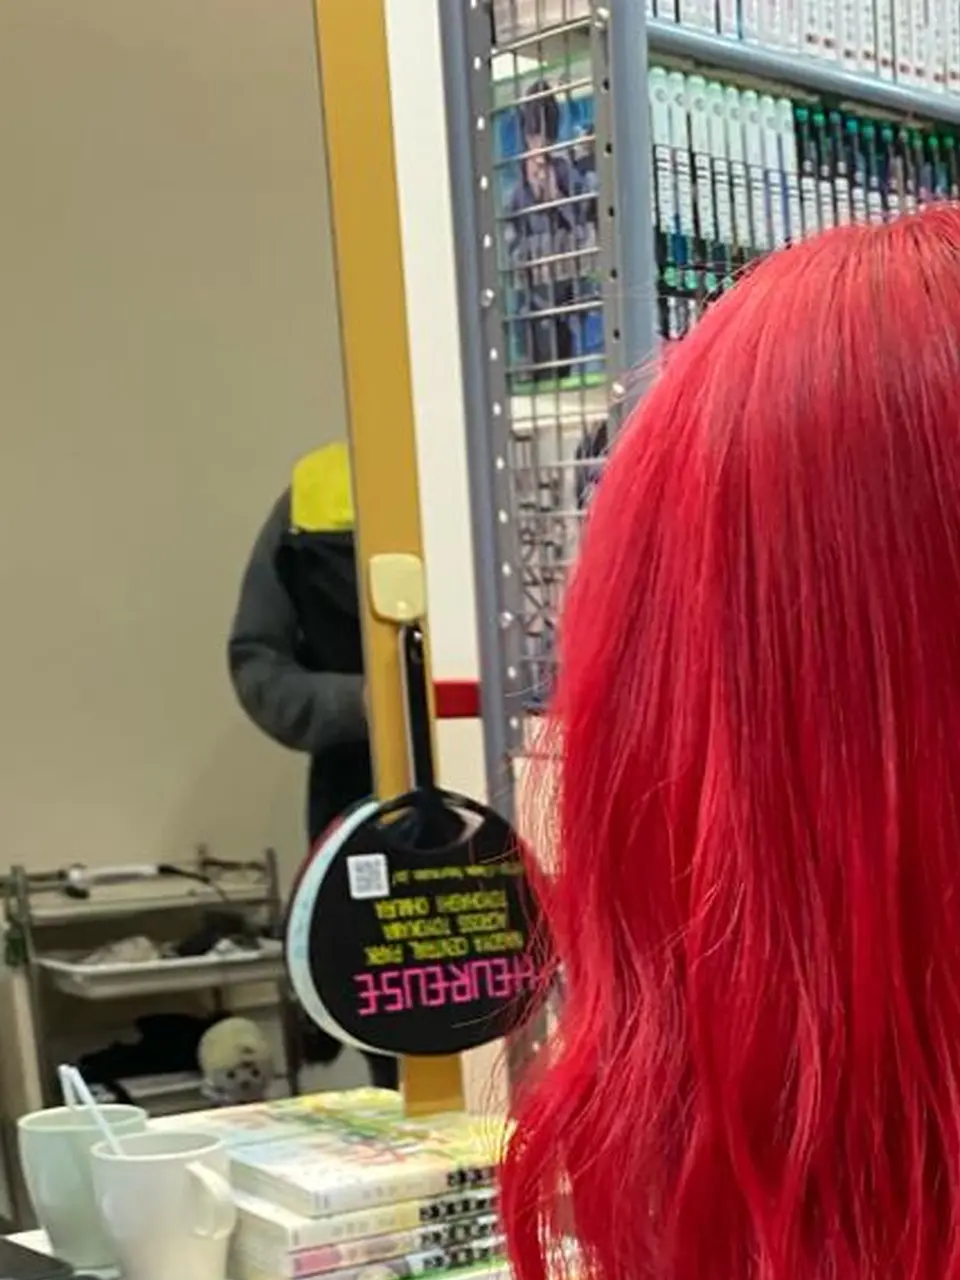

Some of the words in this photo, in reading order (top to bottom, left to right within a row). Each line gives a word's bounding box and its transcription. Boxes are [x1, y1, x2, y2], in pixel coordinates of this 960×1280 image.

[364, 943, 405, 966] PARK
[409, 936, 469, 961] CENTRAL
[353, 954, 536, 1017] HEUREUSE
